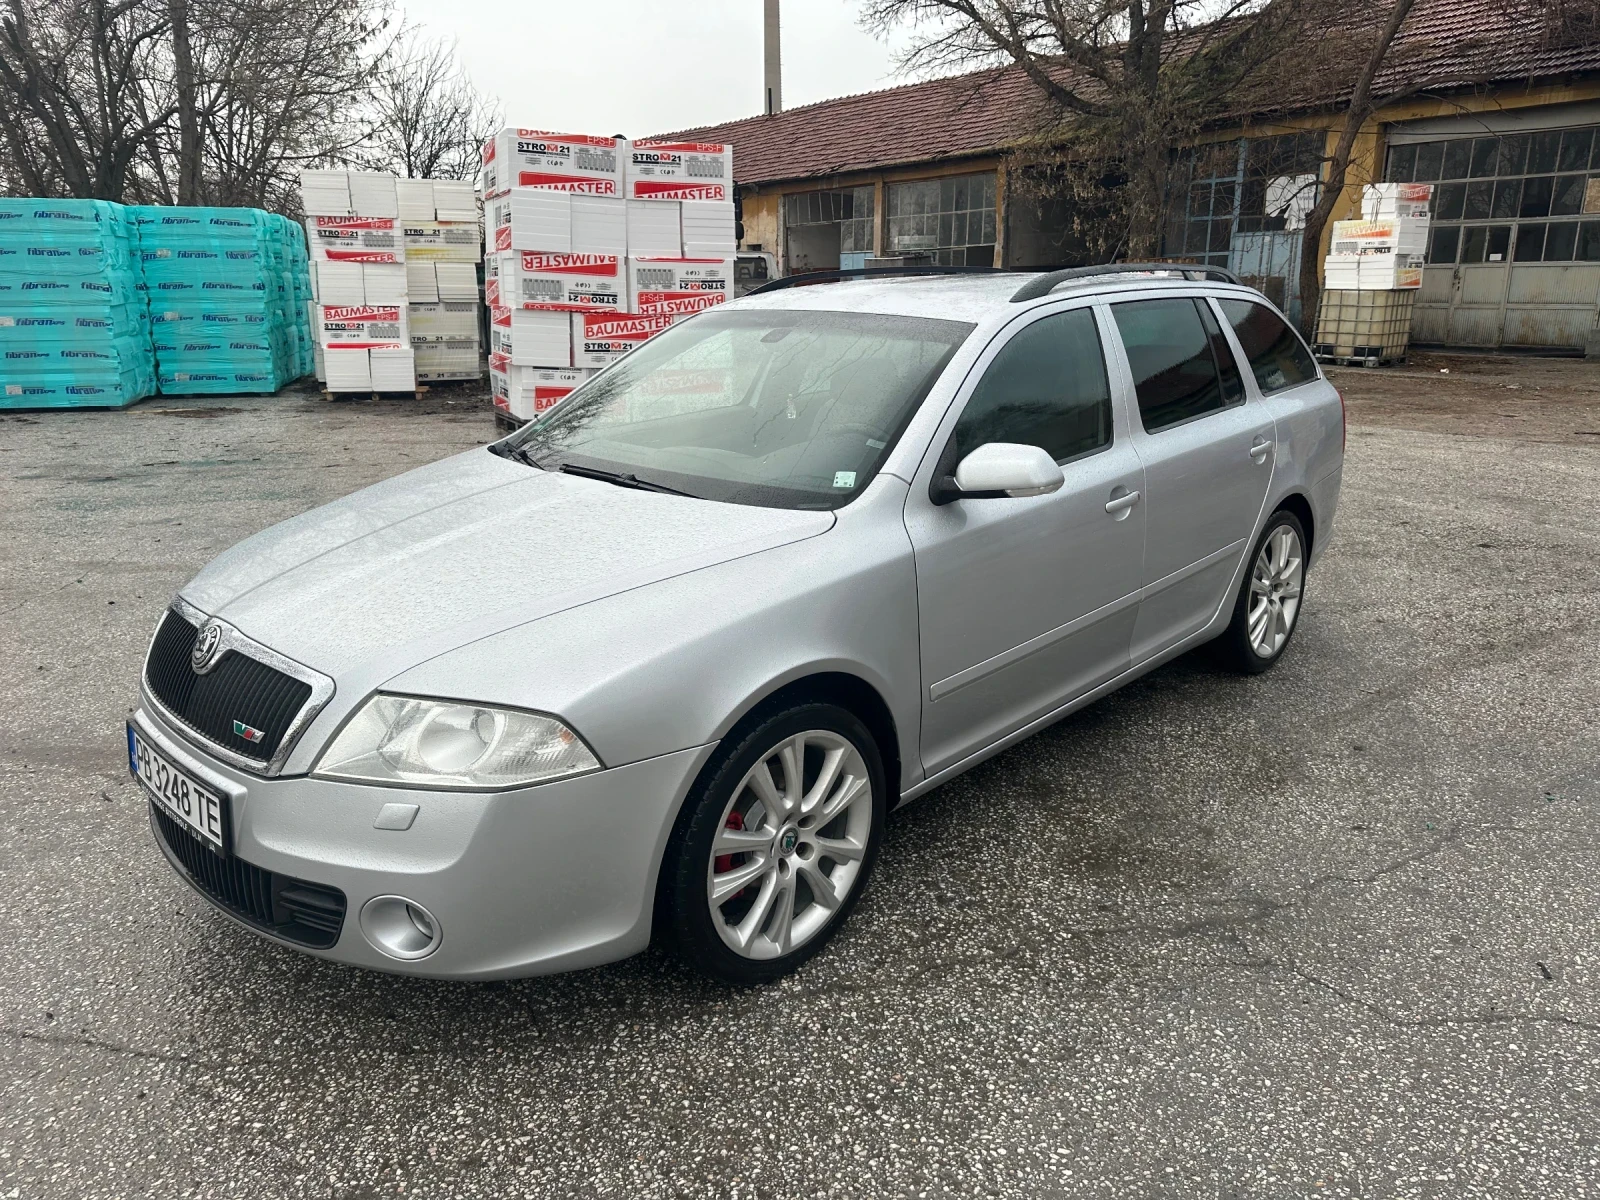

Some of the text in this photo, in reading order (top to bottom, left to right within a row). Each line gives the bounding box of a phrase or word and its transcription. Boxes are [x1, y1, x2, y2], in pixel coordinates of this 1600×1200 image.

[517, 141, 570, 153] STROM 21
[697, 143, 722, 152] EPS-F
[632, 153, 671, 161] STROM
[680, 282, 726, 290] STROM 21
[580, 296, 618, 305] STROM
[641, 293, 665, 302] EPS-F
[641, 294, 724, 315] BAUMASTER
[585, 315, 672, 338] BAUMASTER
[584, 342, 622, 350] STROM
[135, 736, 152, 783] PB
[153, 755, 191, 817] 3248
[193, 786, 221, 840] TE
